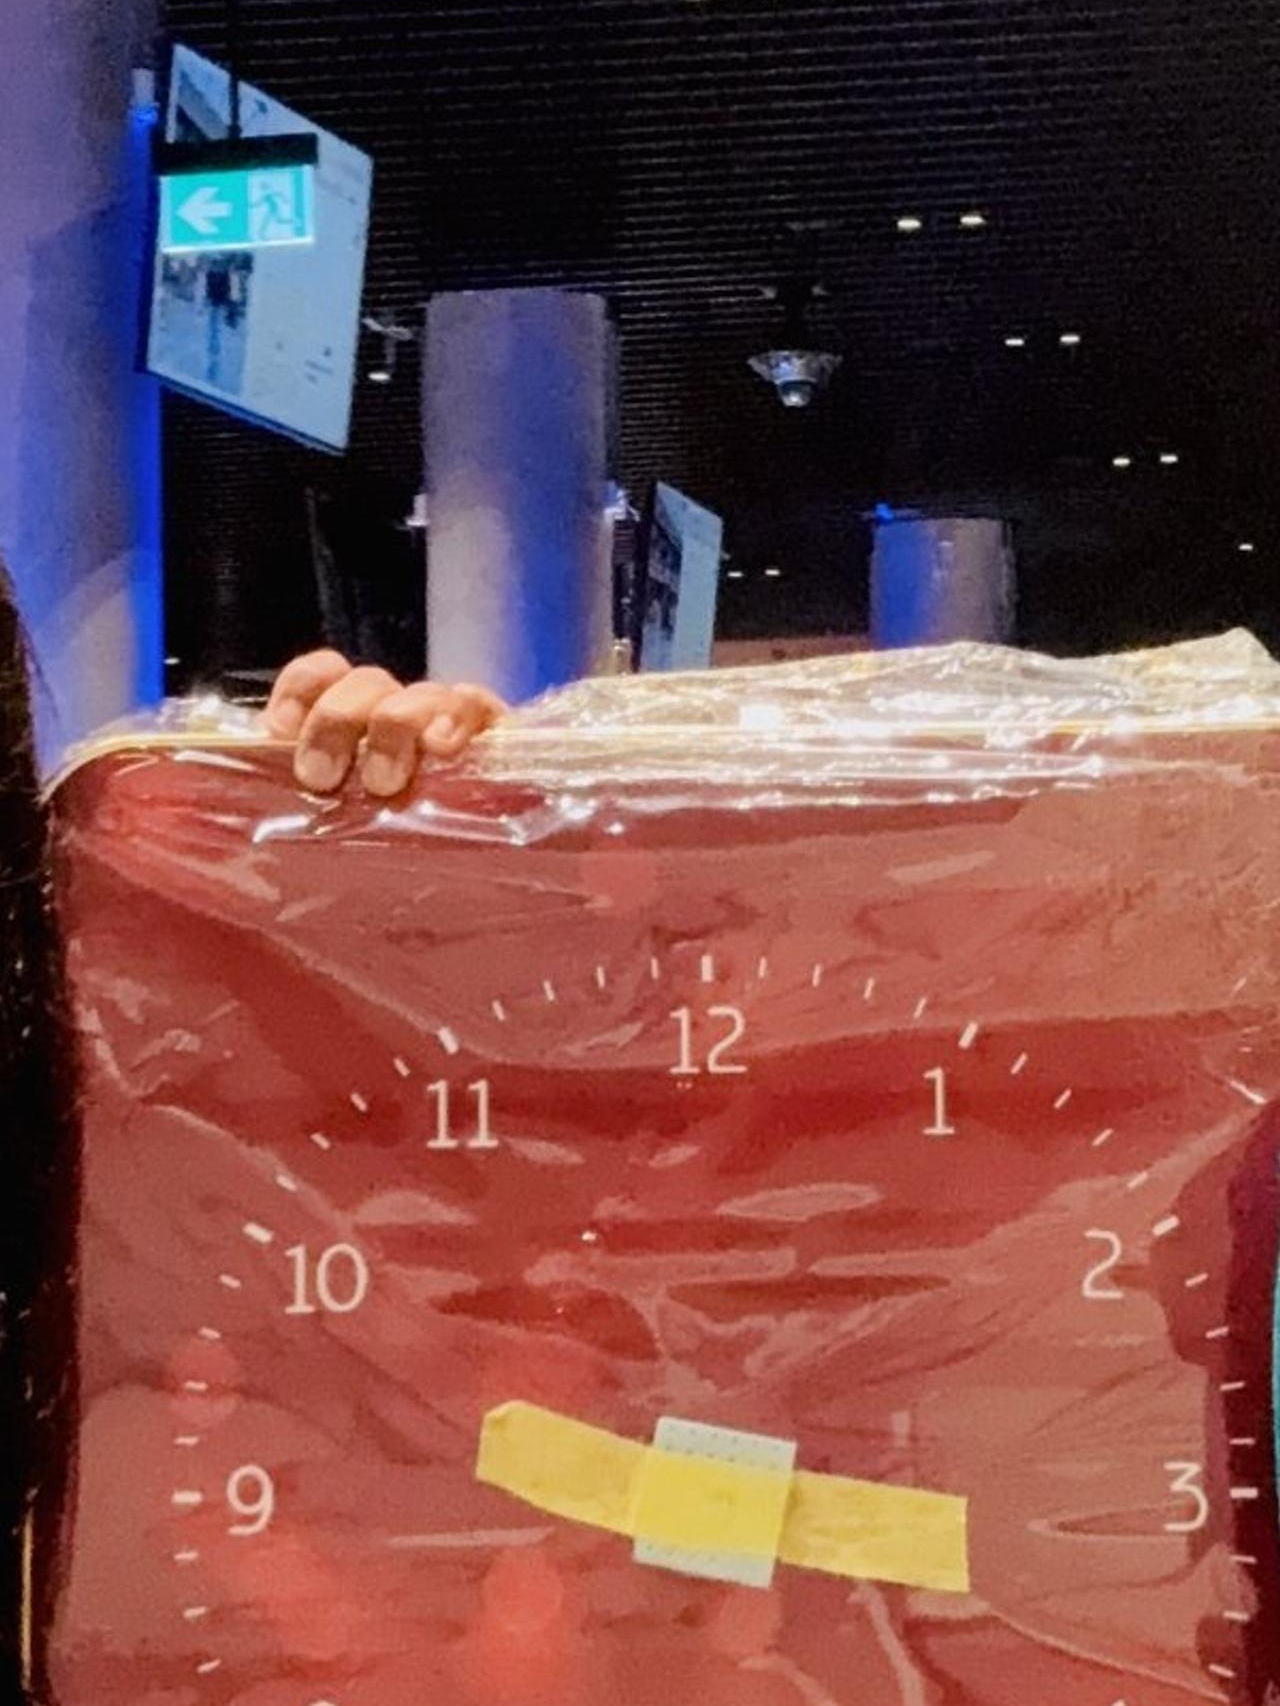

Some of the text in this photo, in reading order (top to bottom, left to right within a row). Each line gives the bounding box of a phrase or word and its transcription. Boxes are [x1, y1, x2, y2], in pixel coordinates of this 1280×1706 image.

[669, 1006, 747, 1076] 12
[425, 1080, 500, 1149] 11
[921, 1068, 956, 1136] 1
[283, 1243, 369, 1313] 10
[1082, 1231, 1123, 1298] 2
[225, 1467, 274, 1535] 9
[1164, 1463, 1208, 1531] 3
